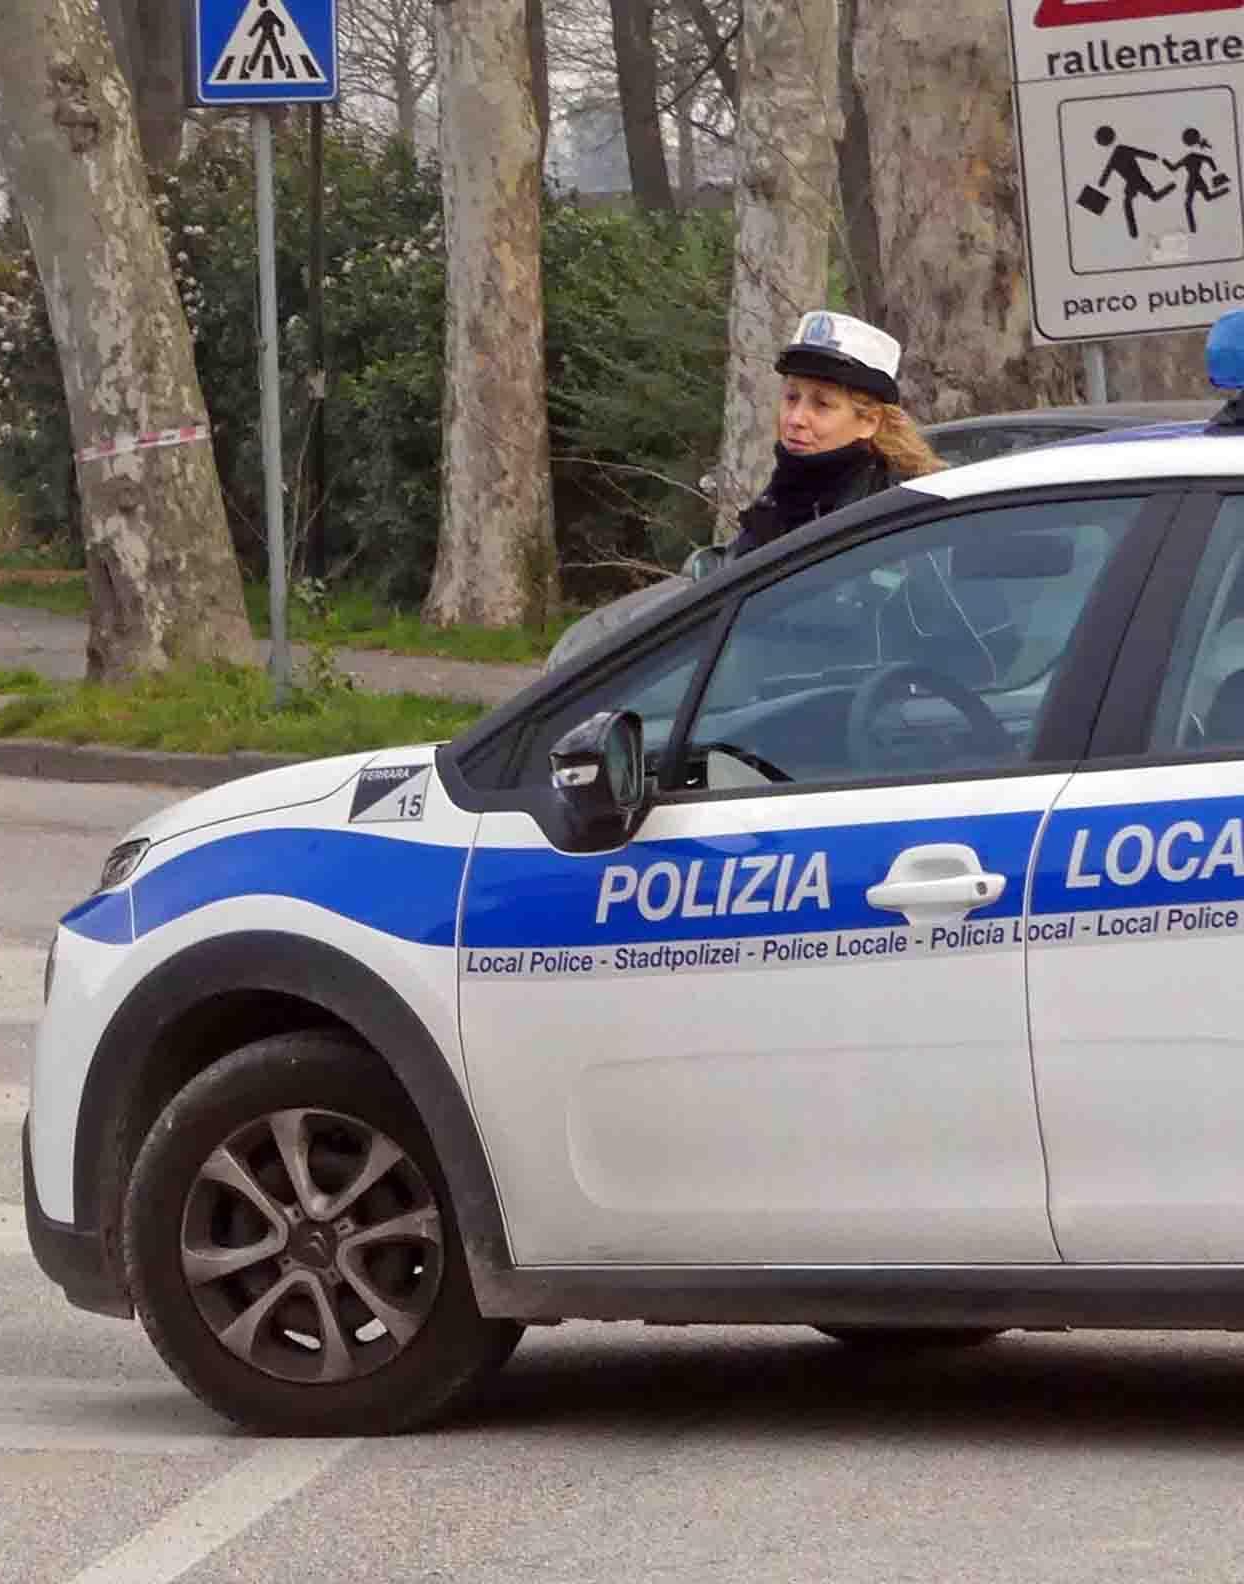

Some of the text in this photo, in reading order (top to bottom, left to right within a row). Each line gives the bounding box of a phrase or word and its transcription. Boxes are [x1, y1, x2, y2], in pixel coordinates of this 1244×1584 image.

[1046, 33, 1243, 76] rallentare
[1063, 293, 1138, 321] parco
[361, 768, 410, 782] FERRARA
[397, 795, 422, 817] 15
[595, 817, 1244, 924] POLIZIA LOCA
[466, 951, 525, 973] Local
[530, 951, 594, 973] Police
[614, 941, 741, 972] Stadtpolizei
[762, 937, 829, 962] Police
[835, 930, 908, 957] Locale
[1012, 916, 1076, 944] Local
[1097, 911, 1160, 937] Local
[1166, 905, 1239, 932] Police
